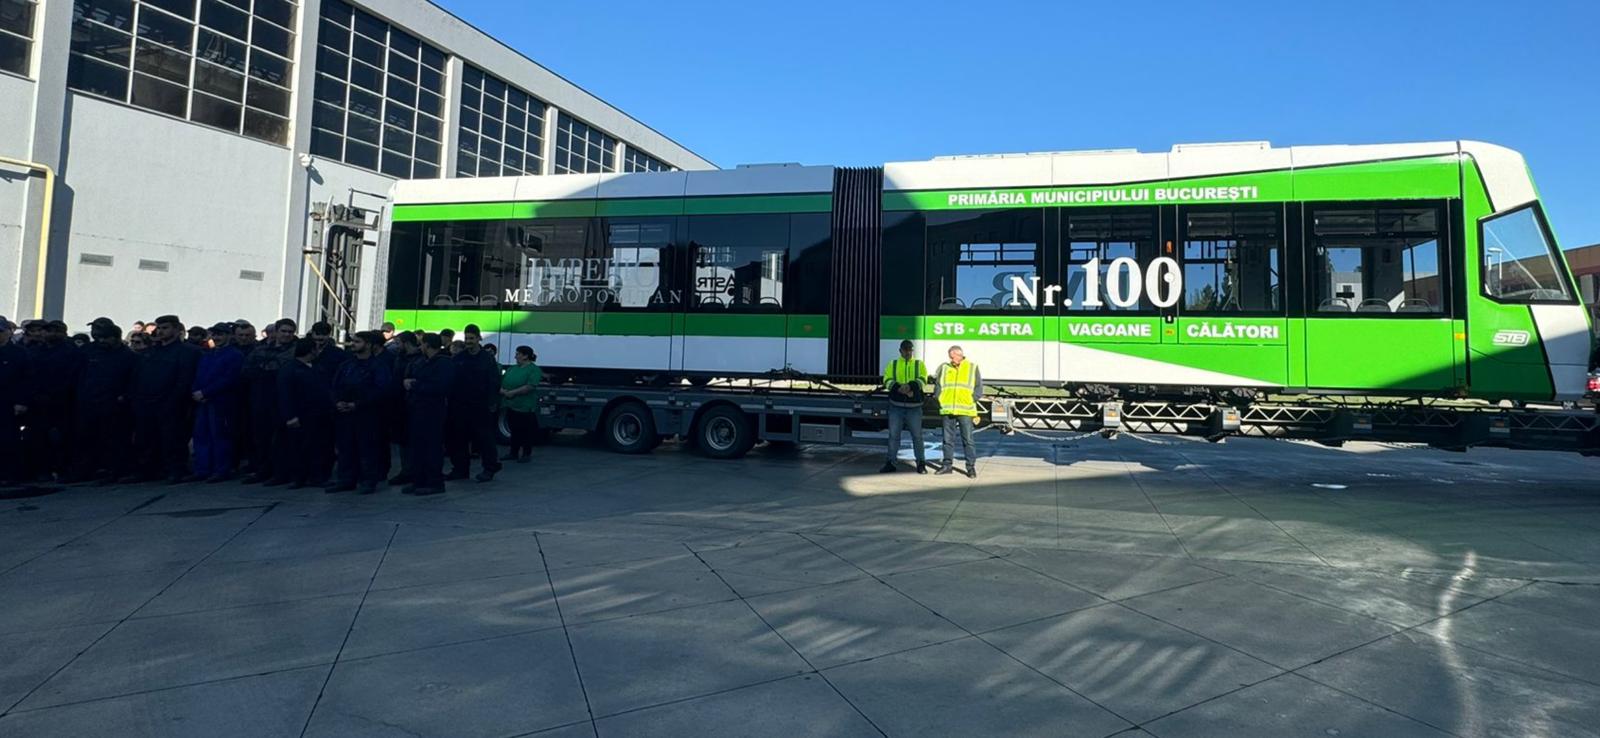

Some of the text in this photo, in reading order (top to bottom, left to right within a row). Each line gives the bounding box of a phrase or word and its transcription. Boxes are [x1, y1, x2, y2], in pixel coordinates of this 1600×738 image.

[948, 190, 1026, 206] PRIMĂRIA
[1031, 188, 1149, 204] MUNICIPIULUI
[933, 322, 964, 336] STB
[978, 323, 1034, 336] ASTRA
[1069, 323, 1152, 337] VAGOANE
[1186, 321, 1279, 339] CĂLĂTORI
[1492, 332, 1527, 343] STB
